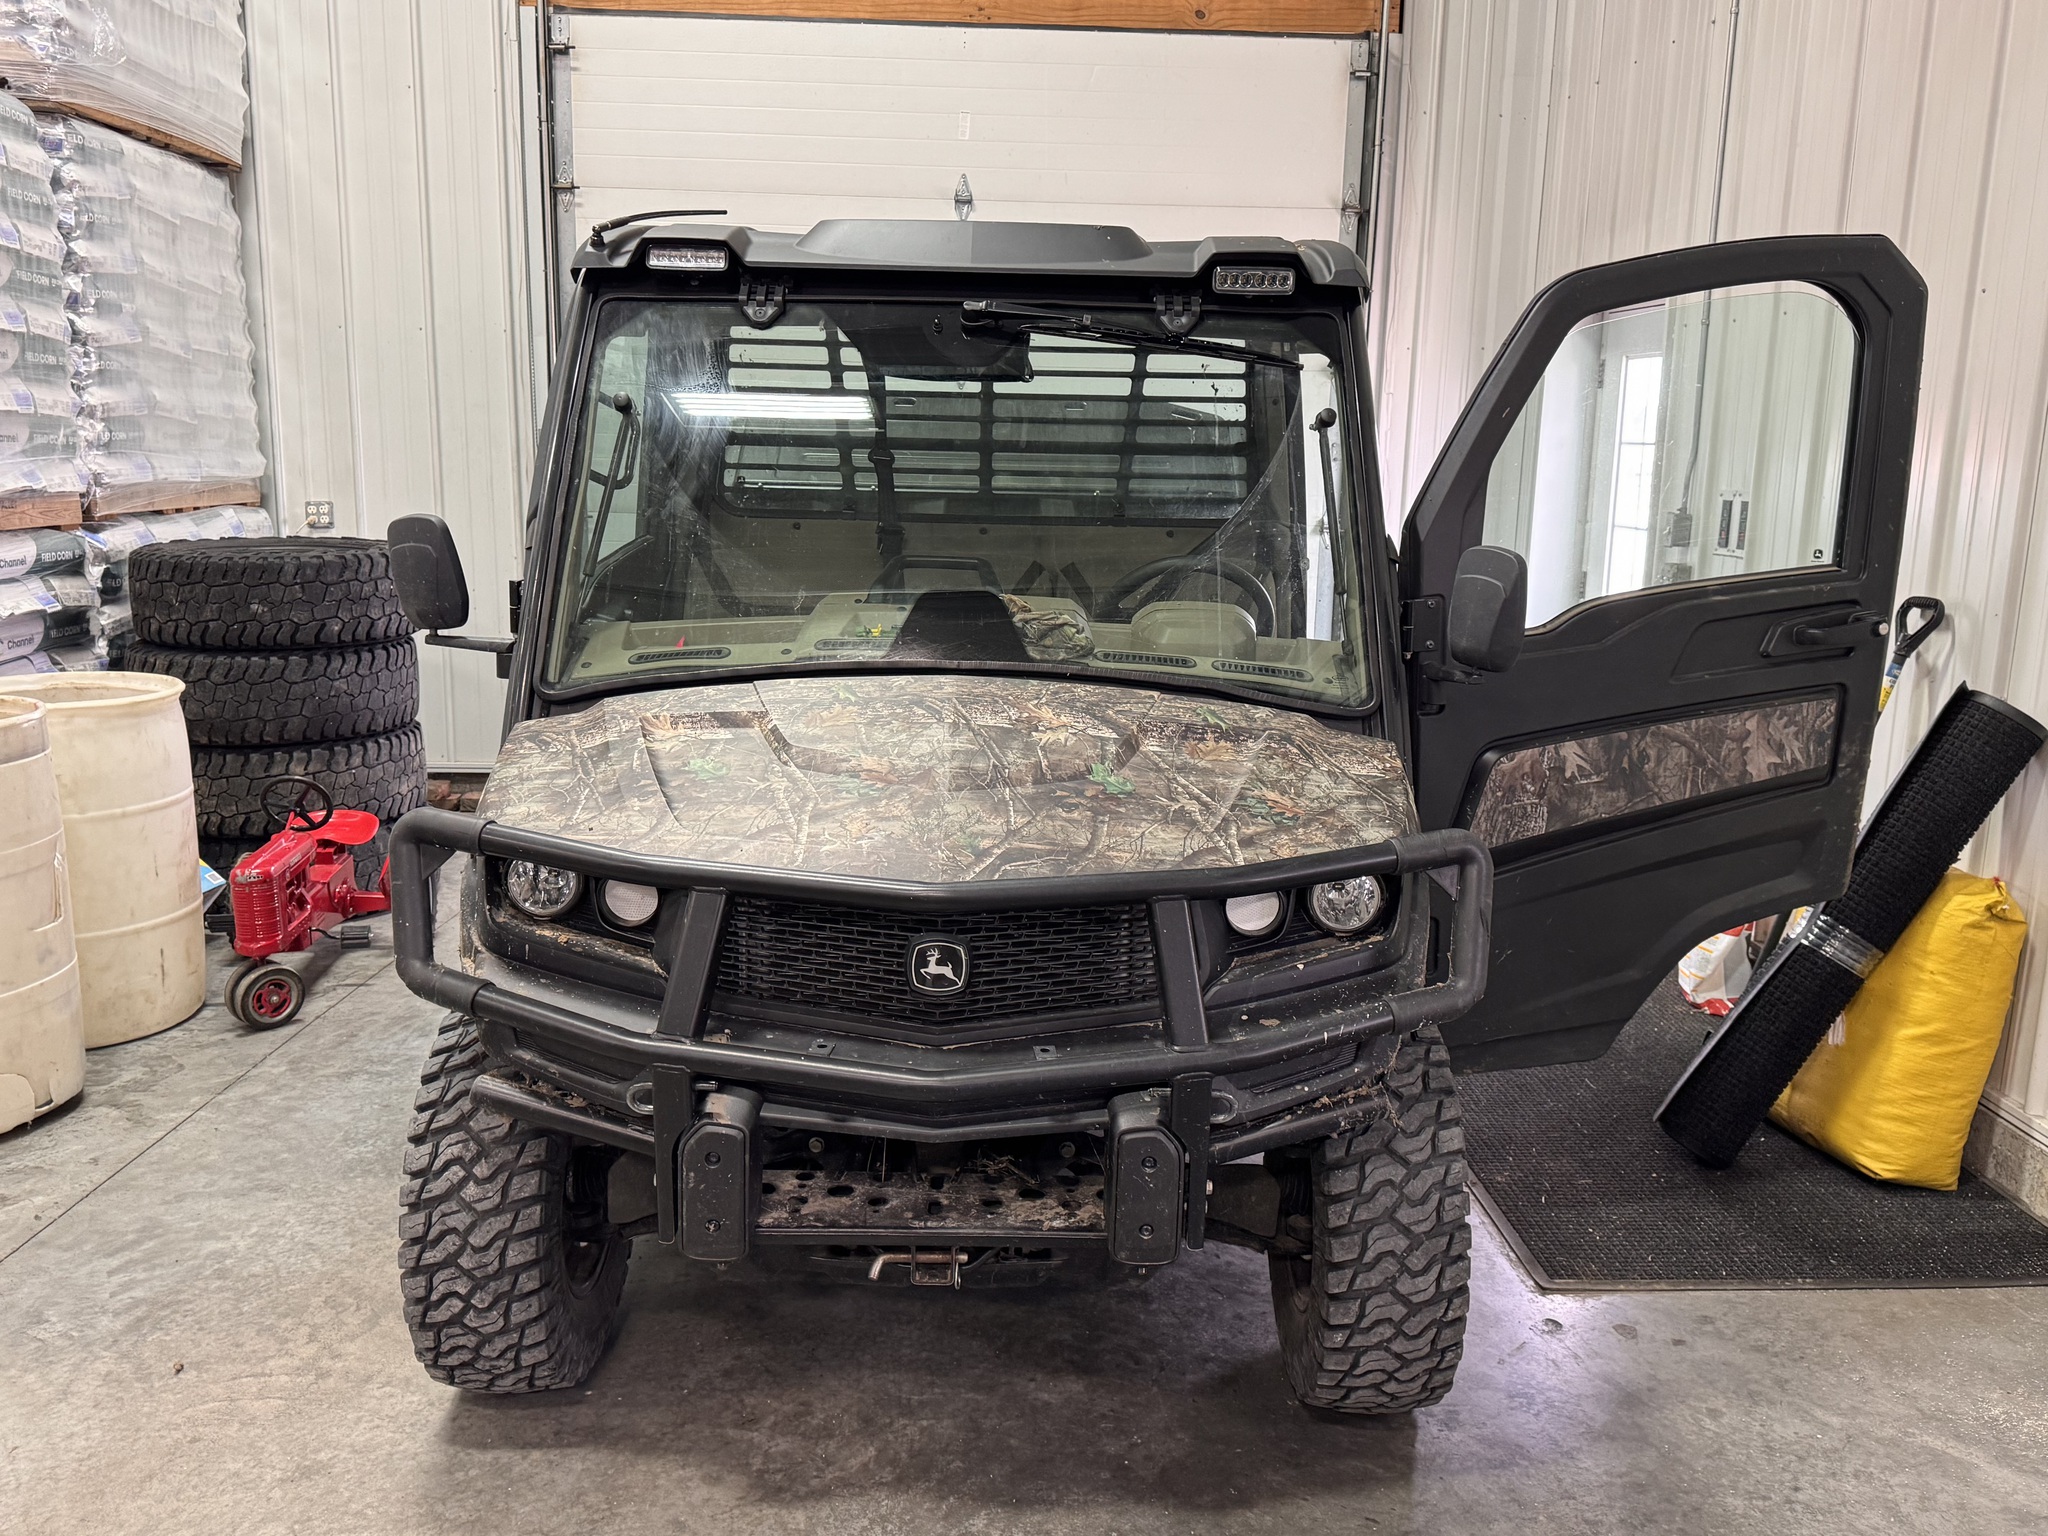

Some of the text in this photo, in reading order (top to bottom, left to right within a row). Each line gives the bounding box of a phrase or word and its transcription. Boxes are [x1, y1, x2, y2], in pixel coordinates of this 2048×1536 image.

[11, 109, 29, 125] CORN
[7, 187, 23, 200] FIELD
[23, 191, 41, 205] CORN
[15, 270, 32, 283] FIELD
[32, 273, 50, 287] CORN
[40, 354, 57, 365] CORN
[111, 432, 127, 441] CORN
[0, 554, 27, 569] Channel
[41, 552, 57, 563] FIELD
[56, 550, 74, 561] CORN
[7, 634, 35, 650] Channel
[64, 626, 81, 636] CORN
